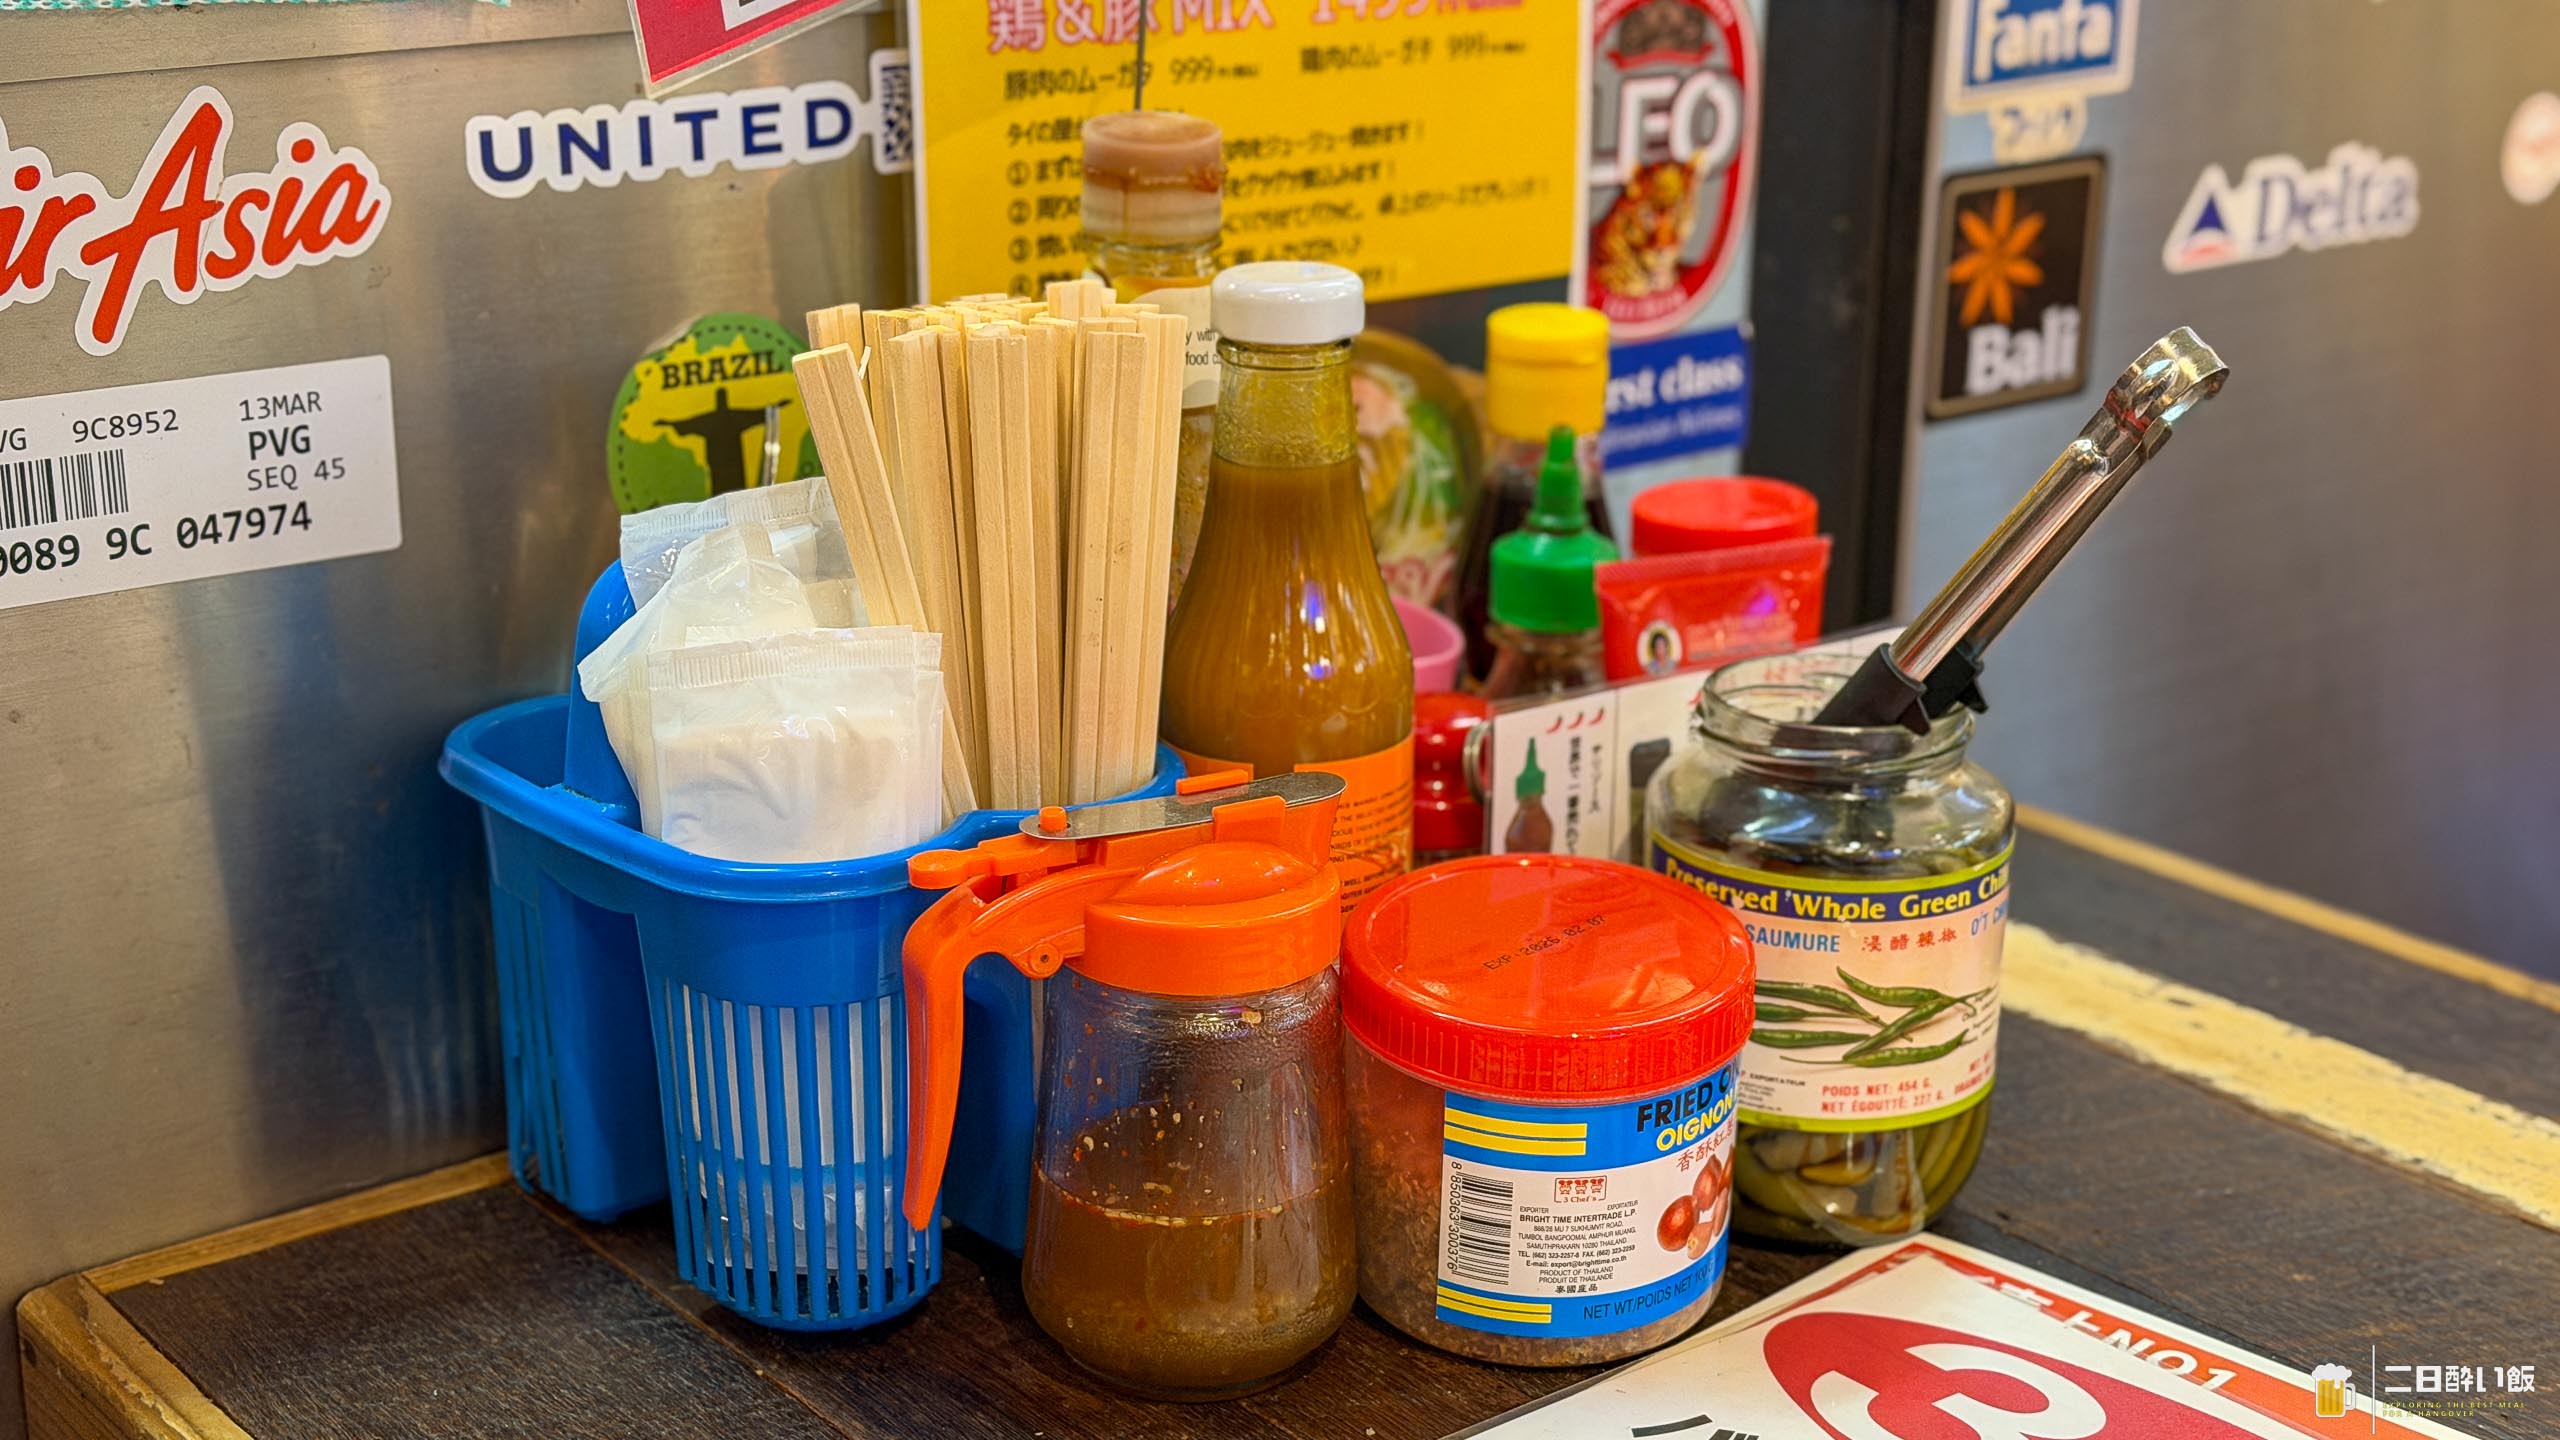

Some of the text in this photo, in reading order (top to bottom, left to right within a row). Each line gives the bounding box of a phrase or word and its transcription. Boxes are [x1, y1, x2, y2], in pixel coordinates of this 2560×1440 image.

[477, 98, 853, 182] UNITED
[2254, 154, 2415, 248] Delta
[0, 102, 381, 344] irAsia
[1966, 305, 2081, 396] Bali
[662, 351, 785, 391] BRAZIL
[239, 391, 323, 421] 13MAR
[72, 408, 179, 443] 9C8952
[248, 424, 311, 461] PVG
[247, 457, 346, 491] SEQ 45
[105, 523, 153, 560] 9C
[176, 500, 313, 549] 047974
[1899, 890, 1972, 918] Green
[1744, 923, 1841, 953] SAUMURE
[1637, 1081, 1713, 1132] FRIED
[1821, 1085, 1860, 1097] POIDS
[1448, 1174, 1462, 1222] 850363
[1518, 1233, 1543, 1241] TUMBOL
[1588, 1230, 1614, 1240] AMPHUR
[1520, 1214, 1550, 1223] BRIGHT
[1552, 1215, 1572, 1223] TIME
[1574, 1213, 1622, 1223] INTERTRADE
[1570, 1223, 1605, 1232] SUKHUMVIT
[1446, 1224, 1460, 1271] 300376
[1526, 1242, 1580, 1250] SAMUTHPRAKARN
[1580, 1273, 1613, 1282] THAILANDE
[1583, 1266, 1614, 1275] THAILAND
[1583, 1303, 1611, 1320] NET
[1613, 1286, 1672, 1316] WT/POIDS
[1673, 1275, 1693, 1297] NET
